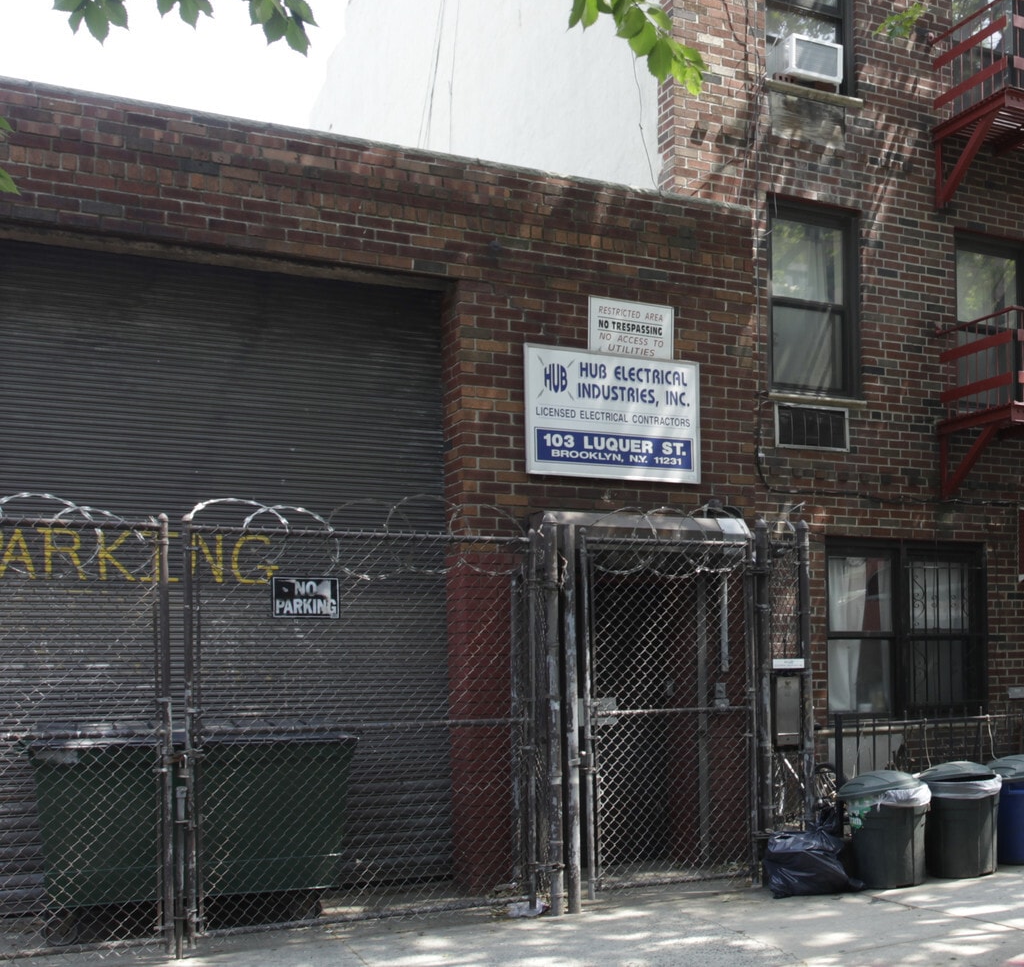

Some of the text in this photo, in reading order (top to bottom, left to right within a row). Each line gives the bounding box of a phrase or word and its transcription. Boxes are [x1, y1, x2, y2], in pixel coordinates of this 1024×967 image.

[598, 305, 664, 323] RESTRICTED AREA
[598, 319, 663, 336] NO TRESPASSING
[599, 332, 664, 348] NO ACCESS TO
[607, 343, 655, 357] UTILITIES
[543, 363, 568, 393] HUB
[579, 361, 688, 387] HUB ELECTRICAL
[577, 382, 691, 408] INDUSTRIES, INC.
[535, 406, 691, 427] LICENSED ELECTRICAL CONTRACTORS
[543, 434, 687, 456] 103 LUQUER ST.
[551, 449, 682, 466] BROOKLYN, N.Y. 11231
[0, 528, 279, 584] ARKING
[295, 581, 317, 596] NO
[275, 598, 337, 614] PARKING
